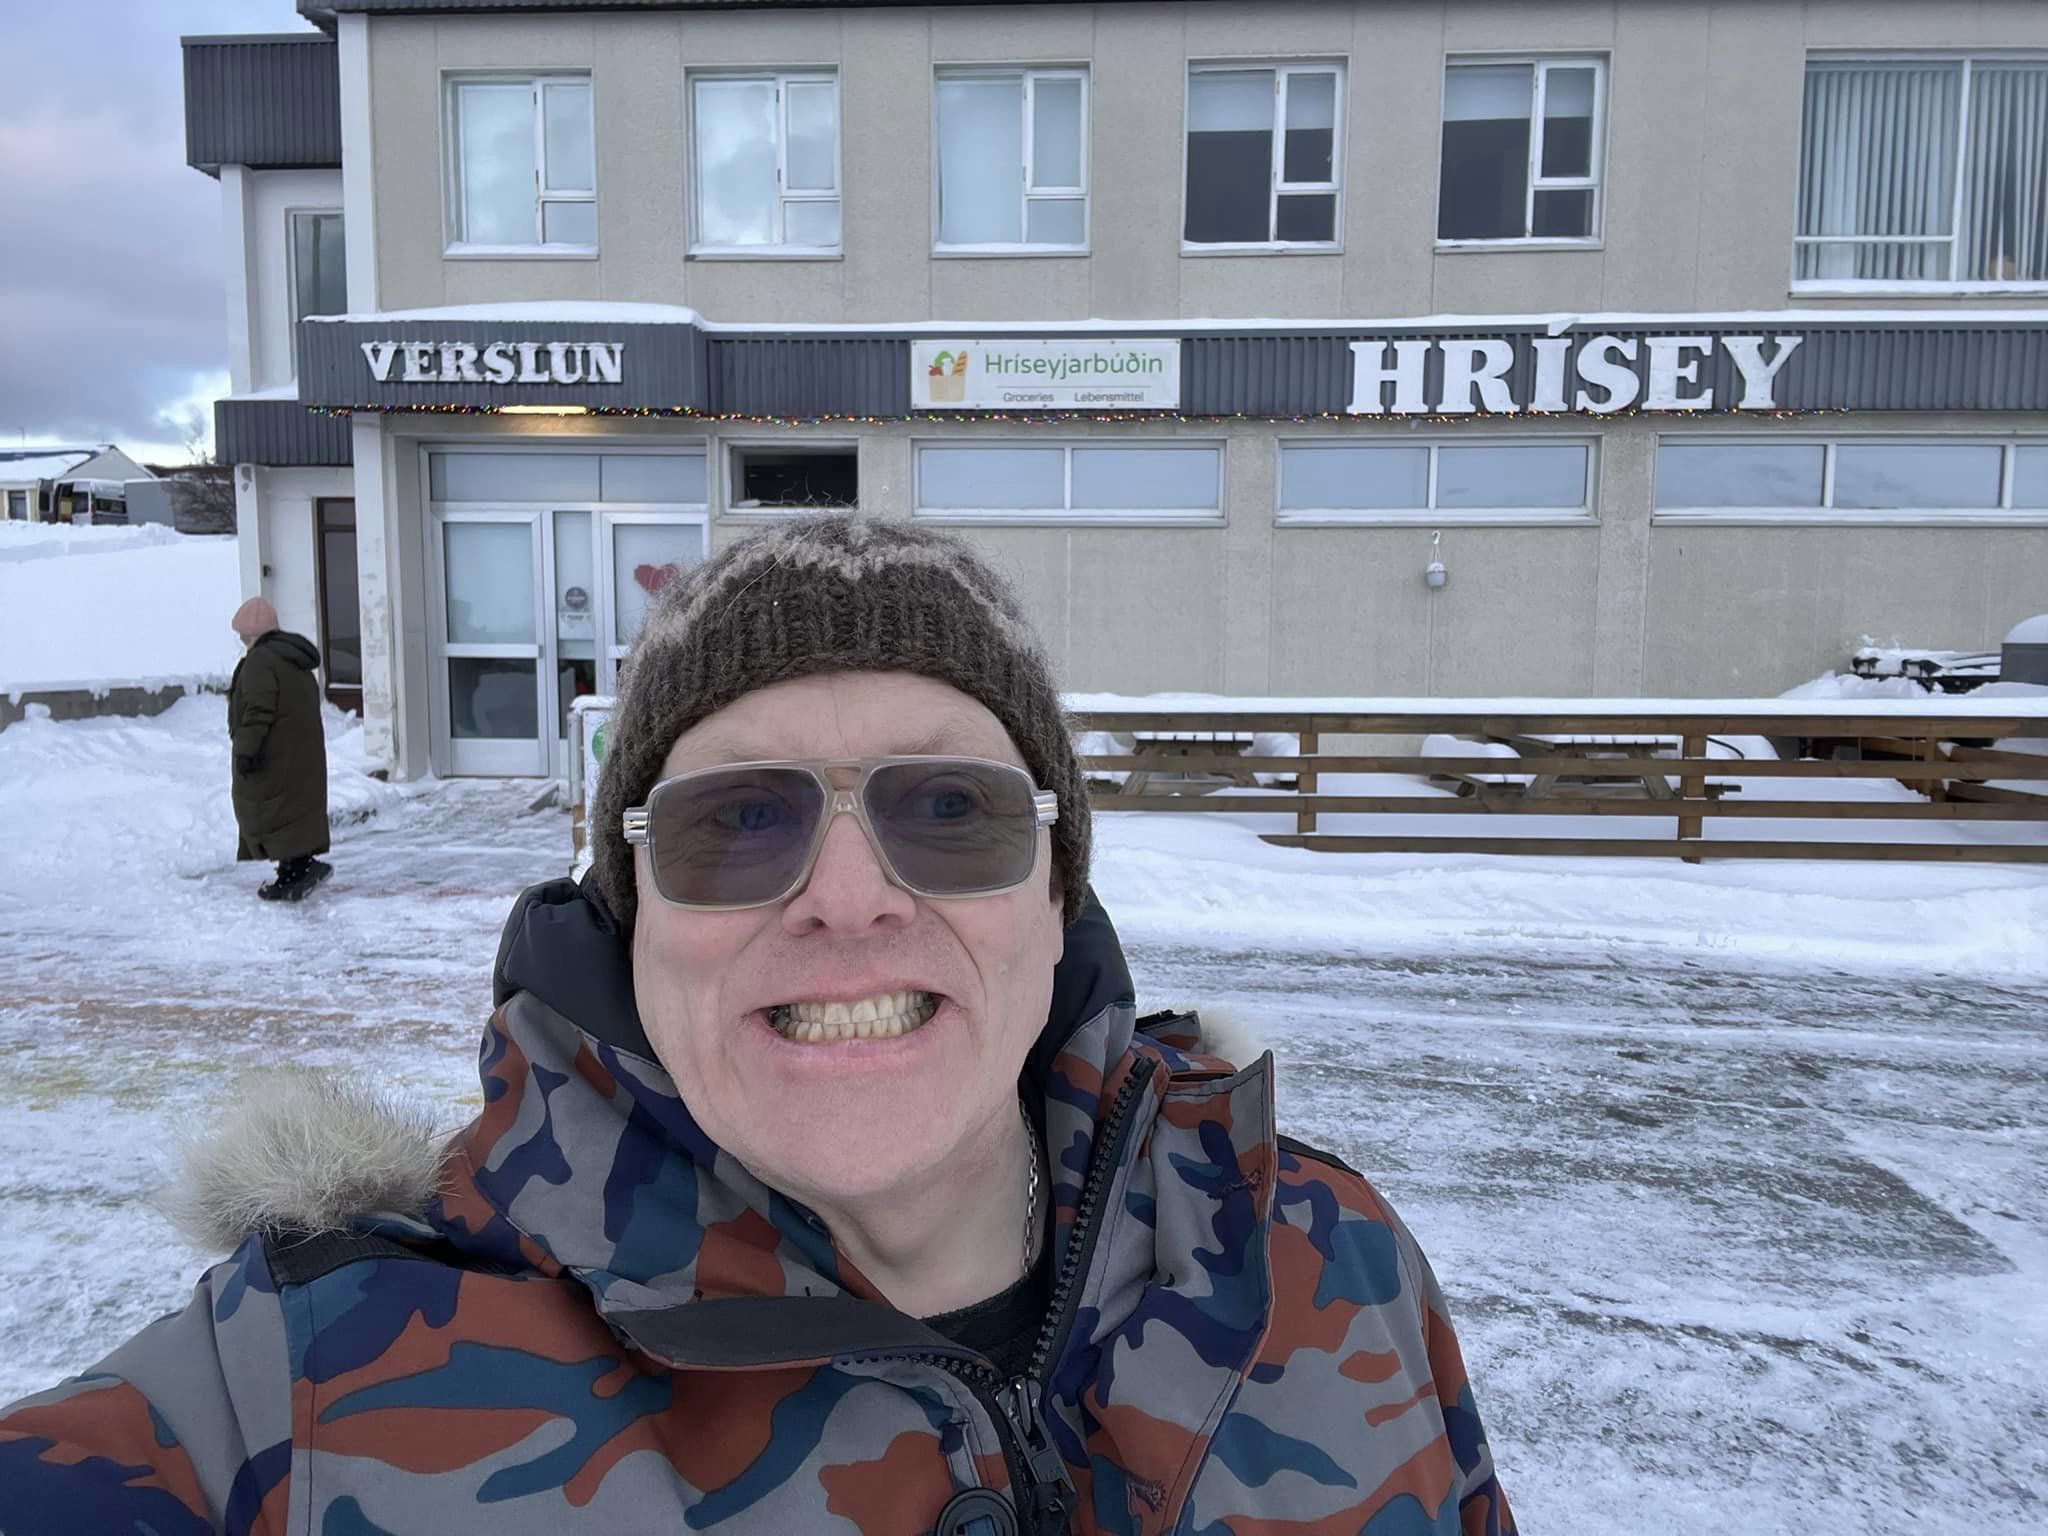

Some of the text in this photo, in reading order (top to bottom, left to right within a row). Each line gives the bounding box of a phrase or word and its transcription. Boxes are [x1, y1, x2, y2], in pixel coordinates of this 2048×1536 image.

[361, 341, 625, 384] VERSLUN
[985, 353, 1163, 379] Hríseyjarbúðin
[1346, 317, 1803, 413] HRÍSEY
[1003, 391, 1144, 403] Groceries Lebensmittel
